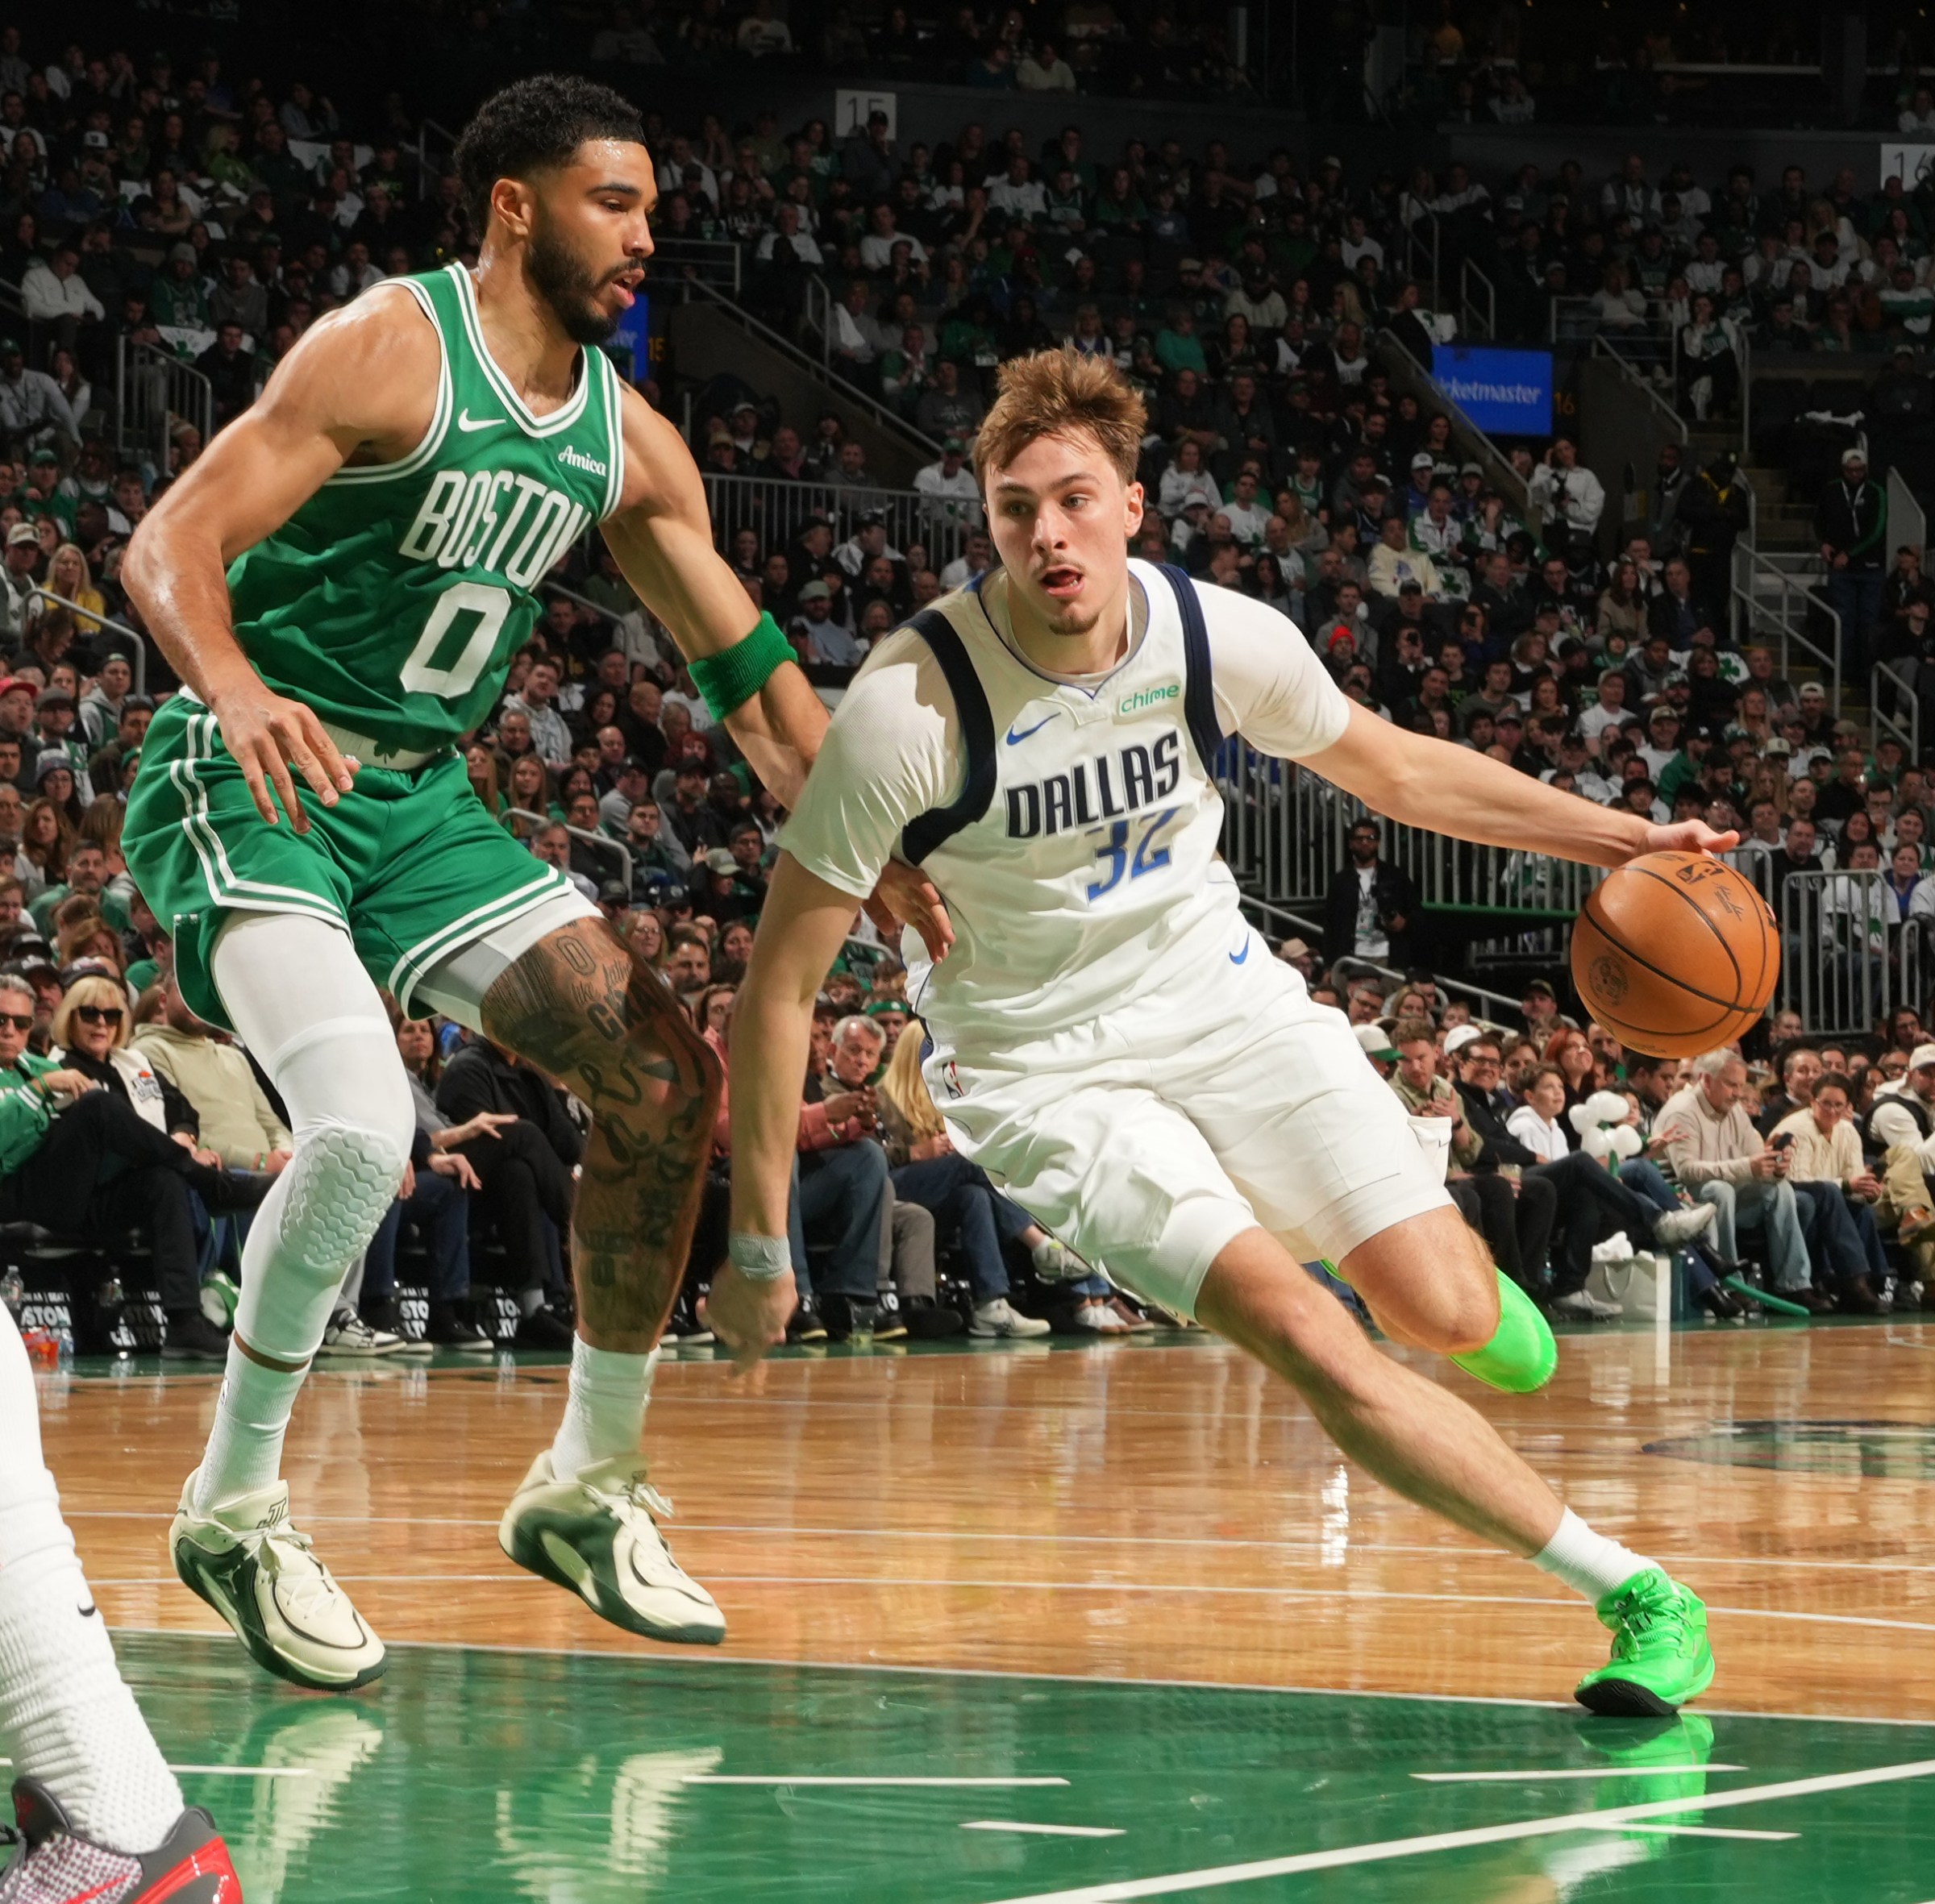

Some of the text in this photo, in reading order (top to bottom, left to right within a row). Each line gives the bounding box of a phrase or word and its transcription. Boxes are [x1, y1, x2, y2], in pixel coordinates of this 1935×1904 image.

[1893, 150, 1932, 183] 16
[1440, 376, 1542, 404] icketmaster
[1554, 391, 1575, 416] 16
[558, 444, 607, 477] Amica
[398, 469, 592, 593] BOSTON
[398, 581, 512, 700] 0
[1121, 684, 1180, 713] chime
[1003, 728, 1180, 839] DALLAS
[1084, 805, 1179, 904] 32
[21, 1305, 73, 1326] STON
